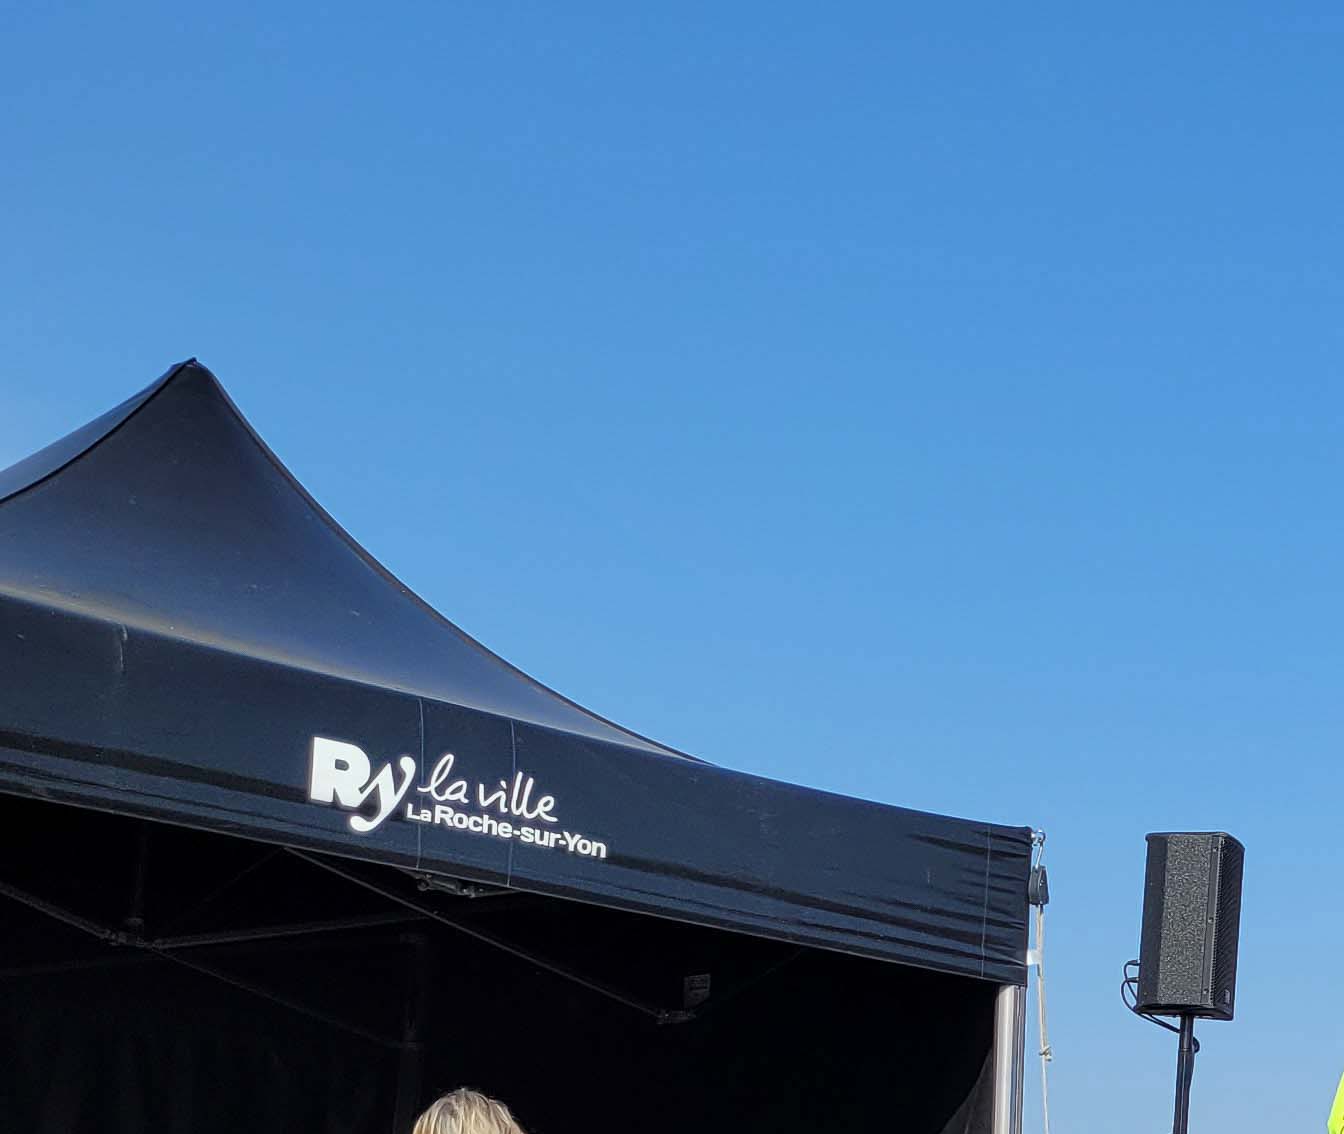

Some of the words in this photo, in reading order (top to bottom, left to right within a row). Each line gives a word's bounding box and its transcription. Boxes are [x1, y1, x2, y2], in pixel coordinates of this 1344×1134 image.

[310, 736, 416, 832] Ry
[417, 754, 469, 803] la
[479, 771, 558, 822] ville
